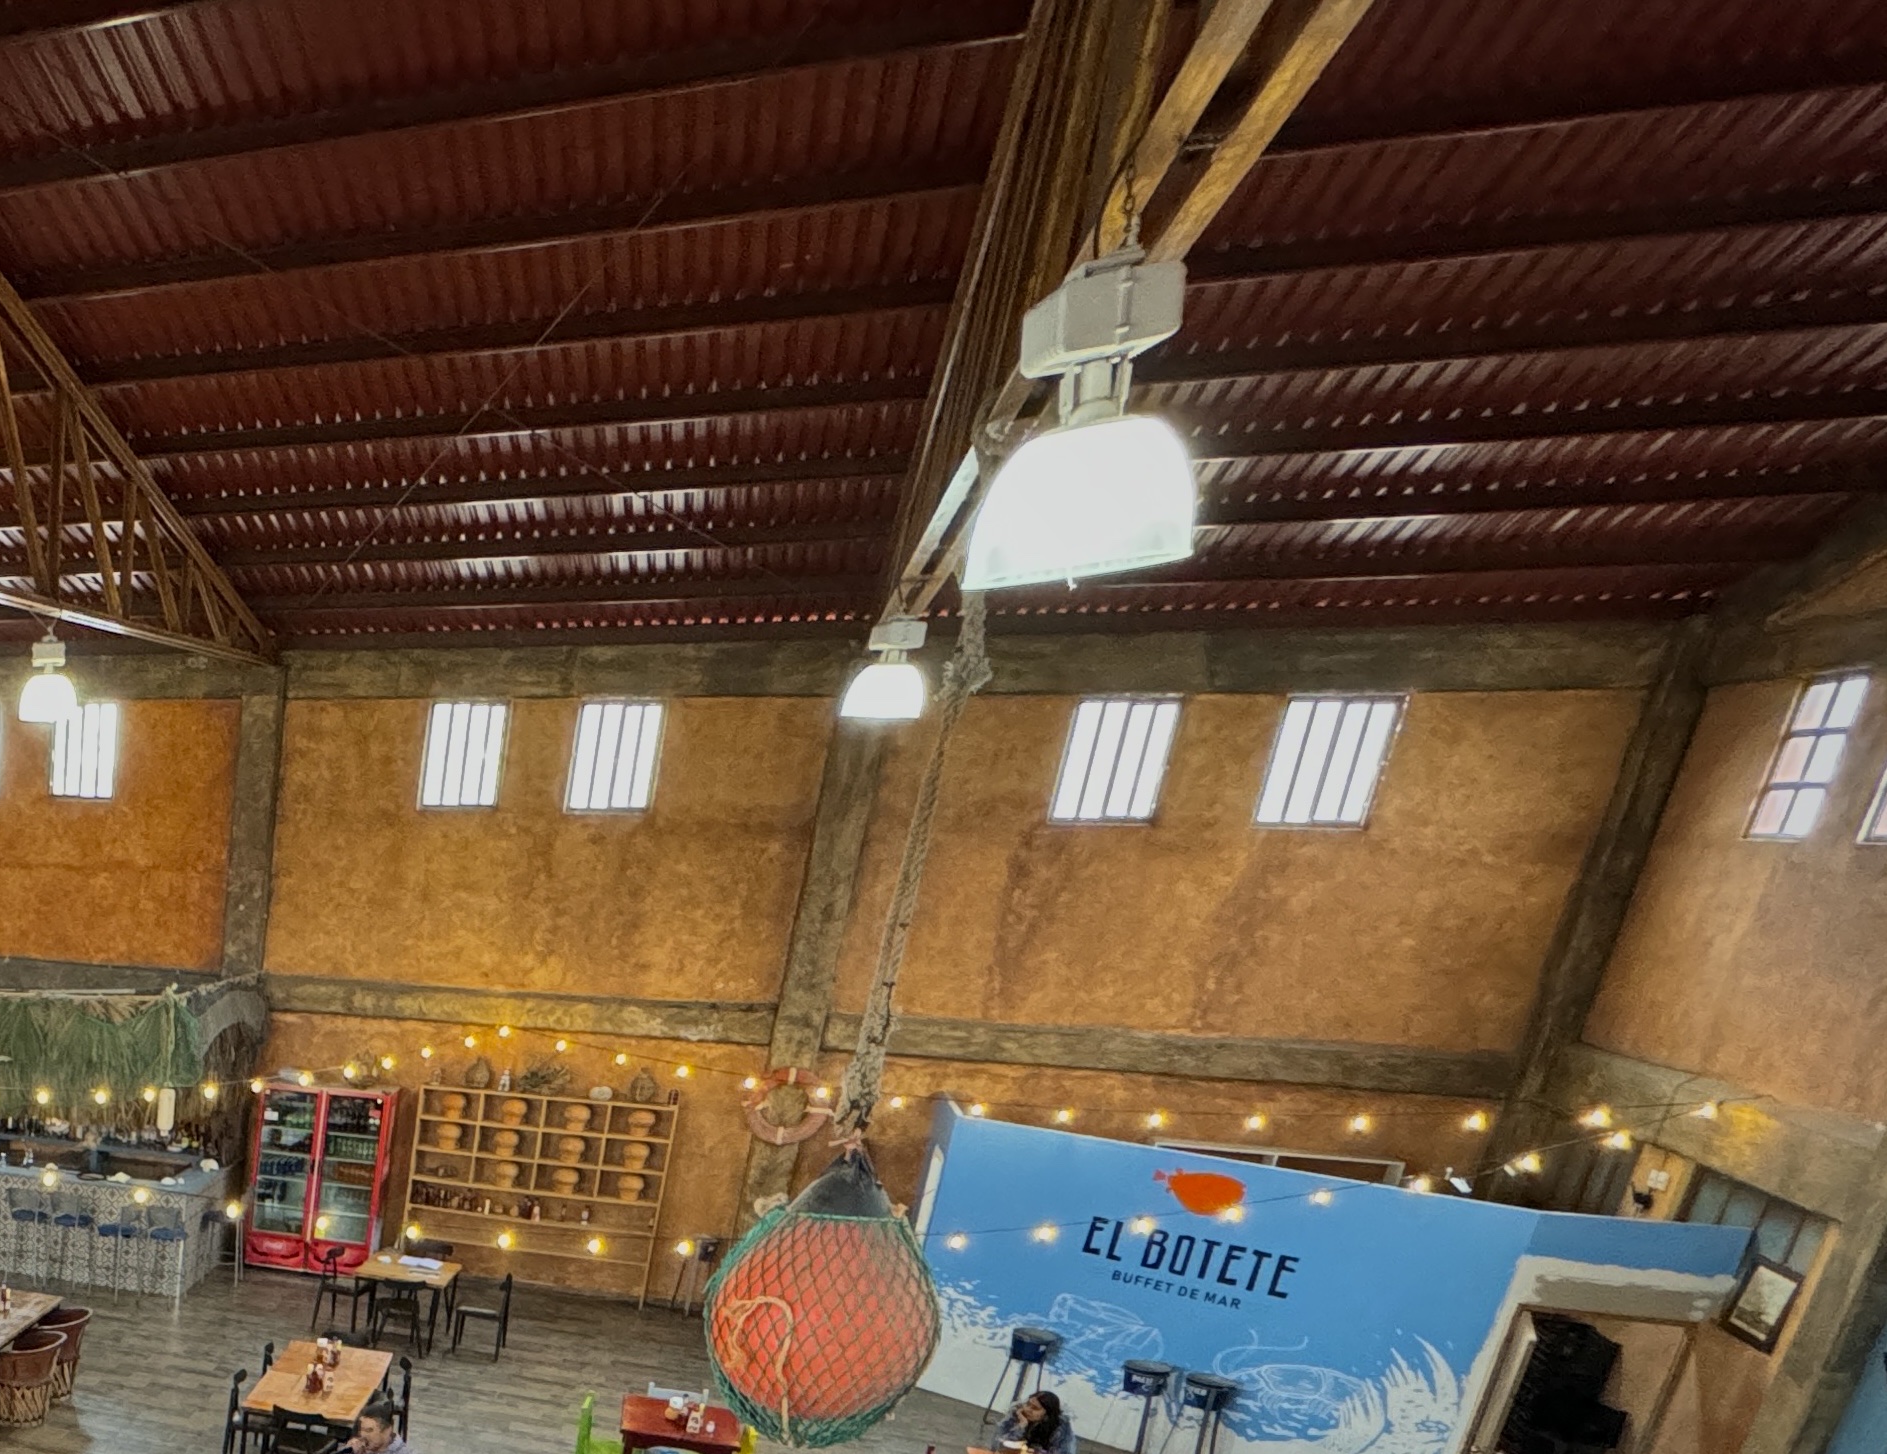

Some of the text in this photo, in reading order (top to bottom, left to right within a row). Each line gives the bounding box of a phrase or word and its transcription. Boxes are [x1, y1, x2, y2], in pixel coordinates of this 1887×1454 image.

[1082, 1216, 1300, 1299] EL BOTETE
[1112, 1270, 1242, 1309] BUFFET DE MAR
